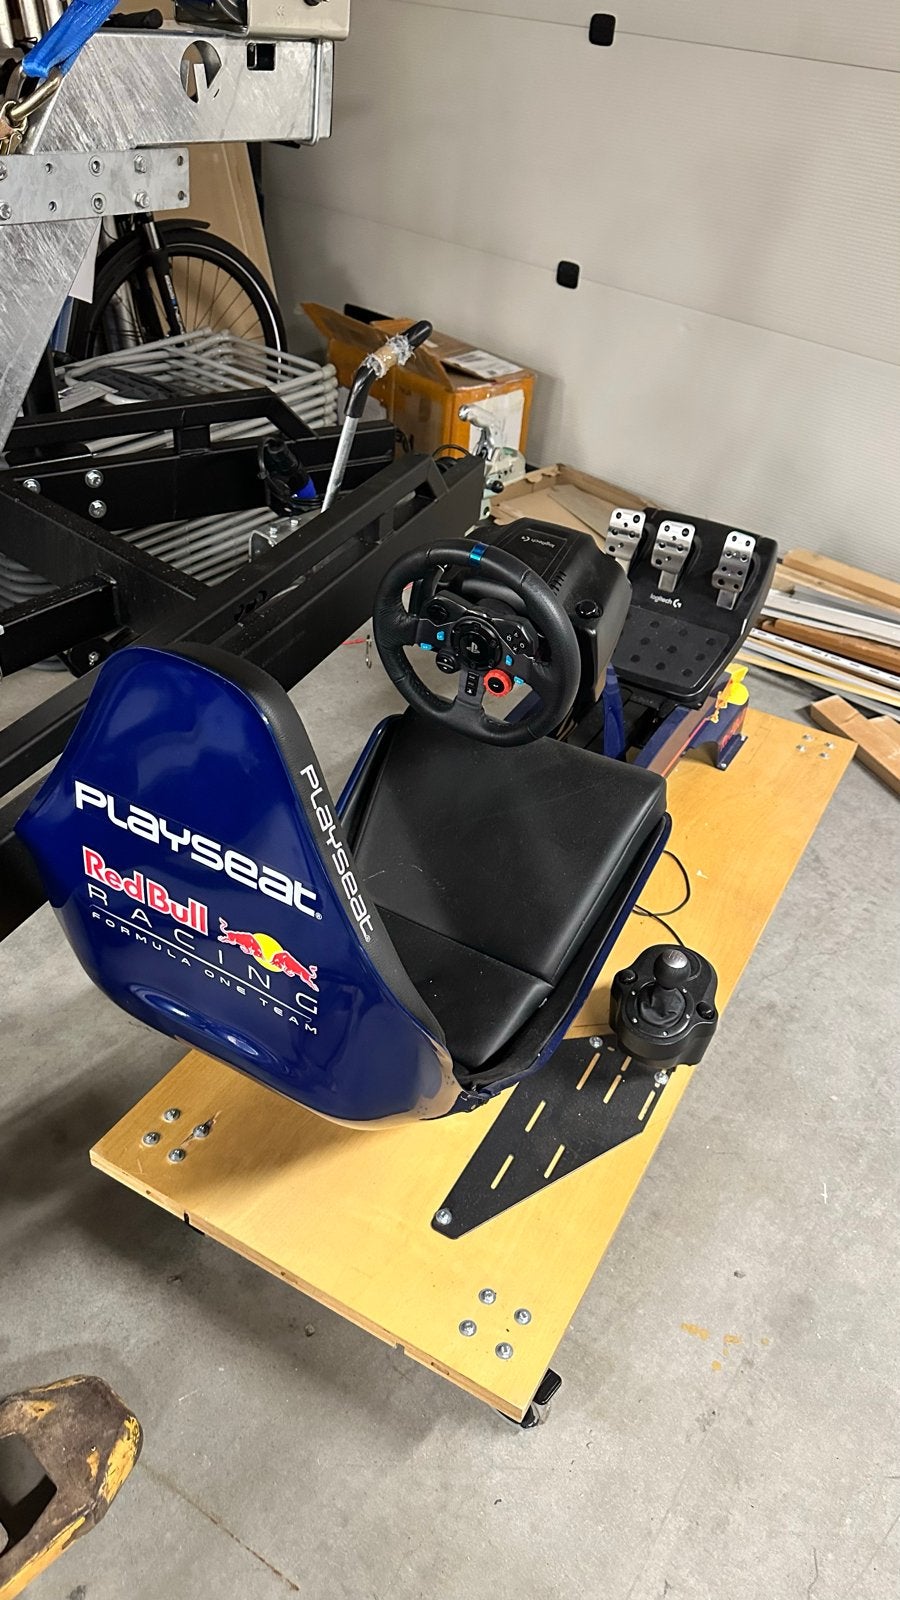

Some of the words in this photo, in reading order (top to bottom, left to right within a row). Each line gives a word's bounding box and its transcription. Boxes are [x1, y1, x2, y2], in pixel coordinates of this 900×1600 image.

[82, 845, 146, 905] Red
[146, 877, 209, 937] Bull
[87, 882, 318, 1015] RACING
[91, 911, 192, 967] FORMULA
[204, 969, 247, 996] ONE
[259, 997, 318, 1035] TEAM
